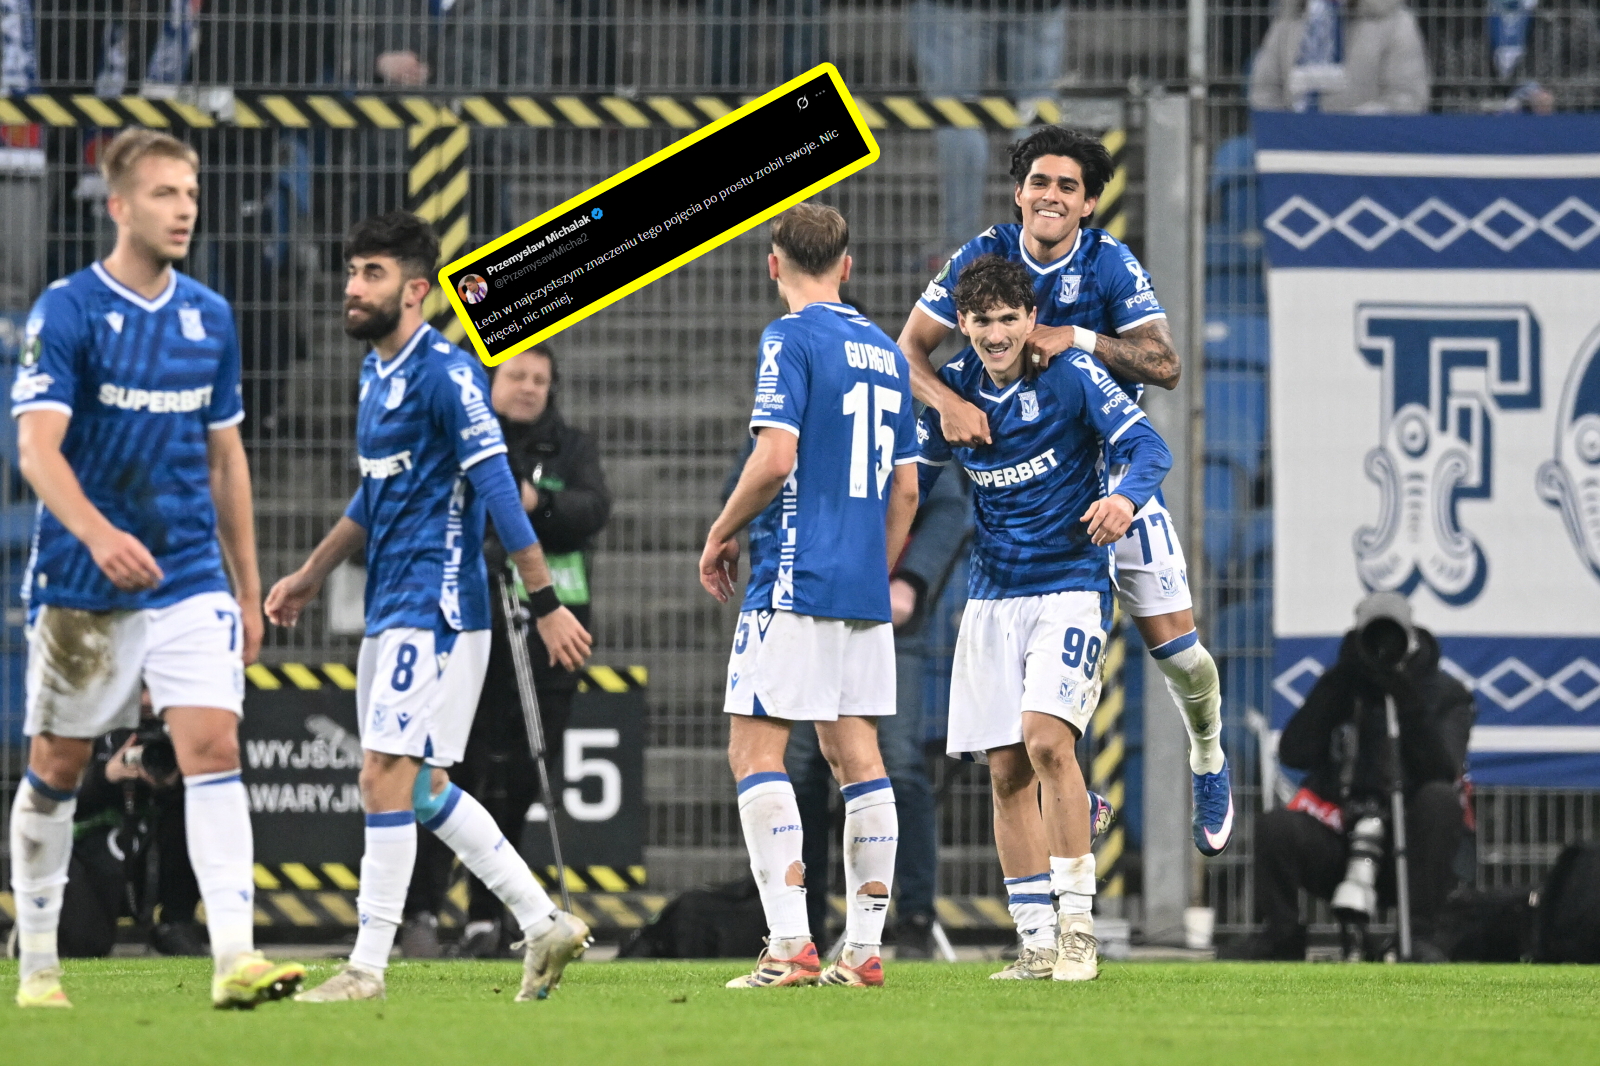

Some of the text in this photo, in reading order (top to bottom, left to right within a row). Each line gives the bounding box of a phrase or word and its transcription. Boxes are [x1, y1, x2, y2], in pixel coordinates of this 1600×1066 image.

[844, 340, 900, 379] GURGUL
[843, 381, 902, 500] 15
[963, 447, 1058, 488] SUPERBET
[1125, 512, 1174, 566] 77
[215, 608, 237, 652] 7
[391, 643, 418, 692] 8
[1061, 626, 1102, 681] 99
[247, 782, 361, 814] WARYJN
